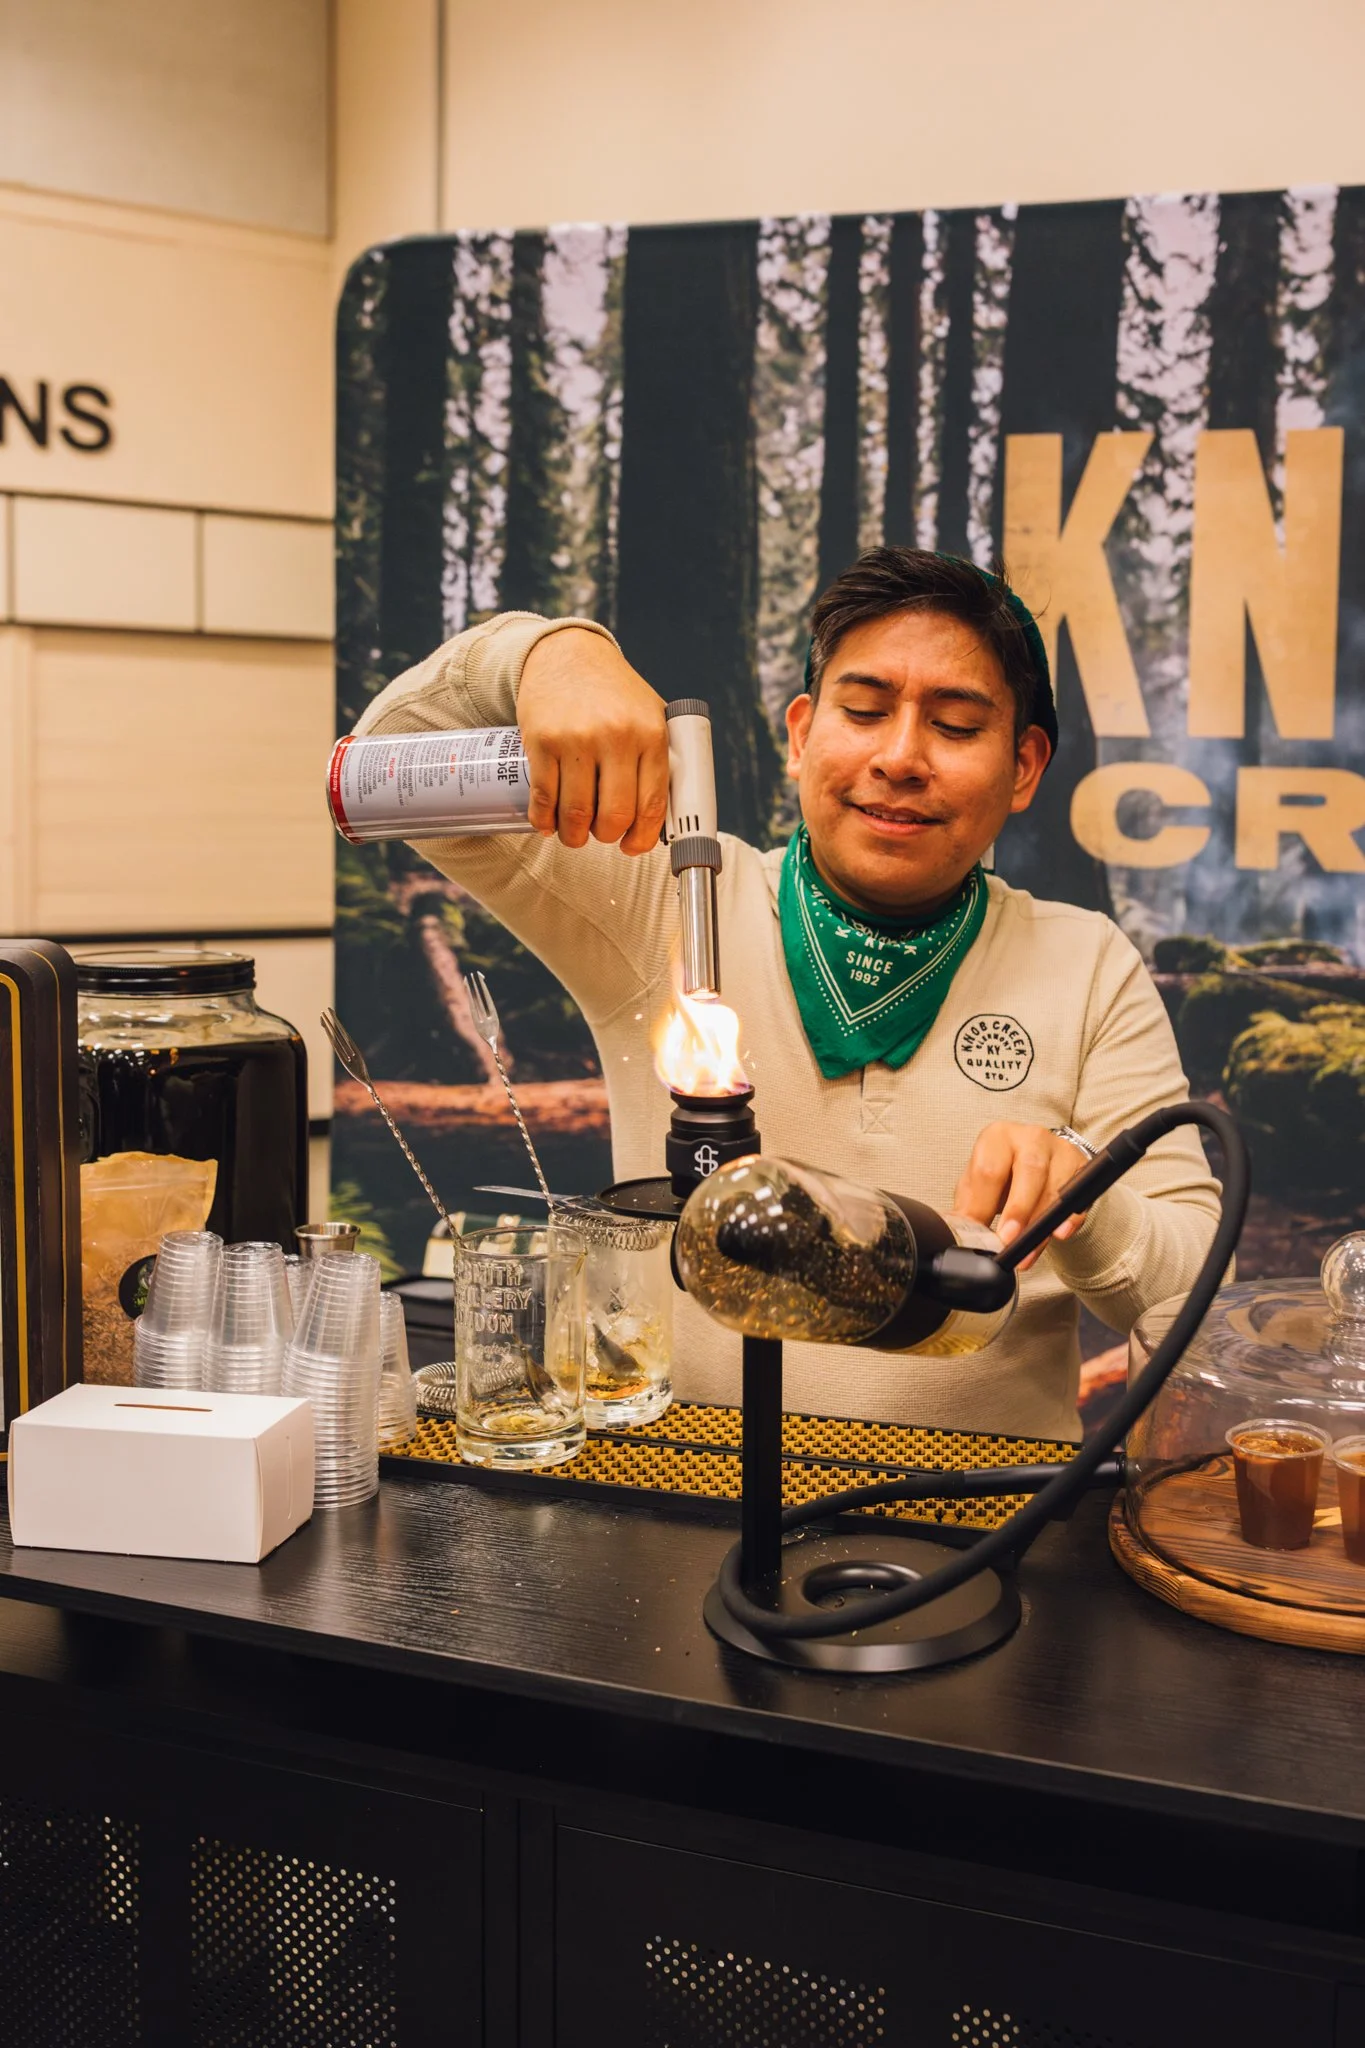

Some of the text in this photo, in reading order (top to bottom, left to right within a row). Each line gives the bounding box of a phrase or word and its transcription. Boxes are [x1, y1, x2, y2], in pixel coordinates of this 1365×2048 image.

[0, 375, 113, 453] NS
[1003, 427, 1344, 740] KN
[508, 760, 519, 786] FUEL
[1070, 761, 1365, 873] CR
[846, 950, 894, 975] SINCE
[850, 969, 880, 987] 1992
[961, 1020, 1028, 1057] KNOB CREEK
[986, 1044, 1001, 1055] KY
[966, 1058, 1022, 1070] QUALITY
